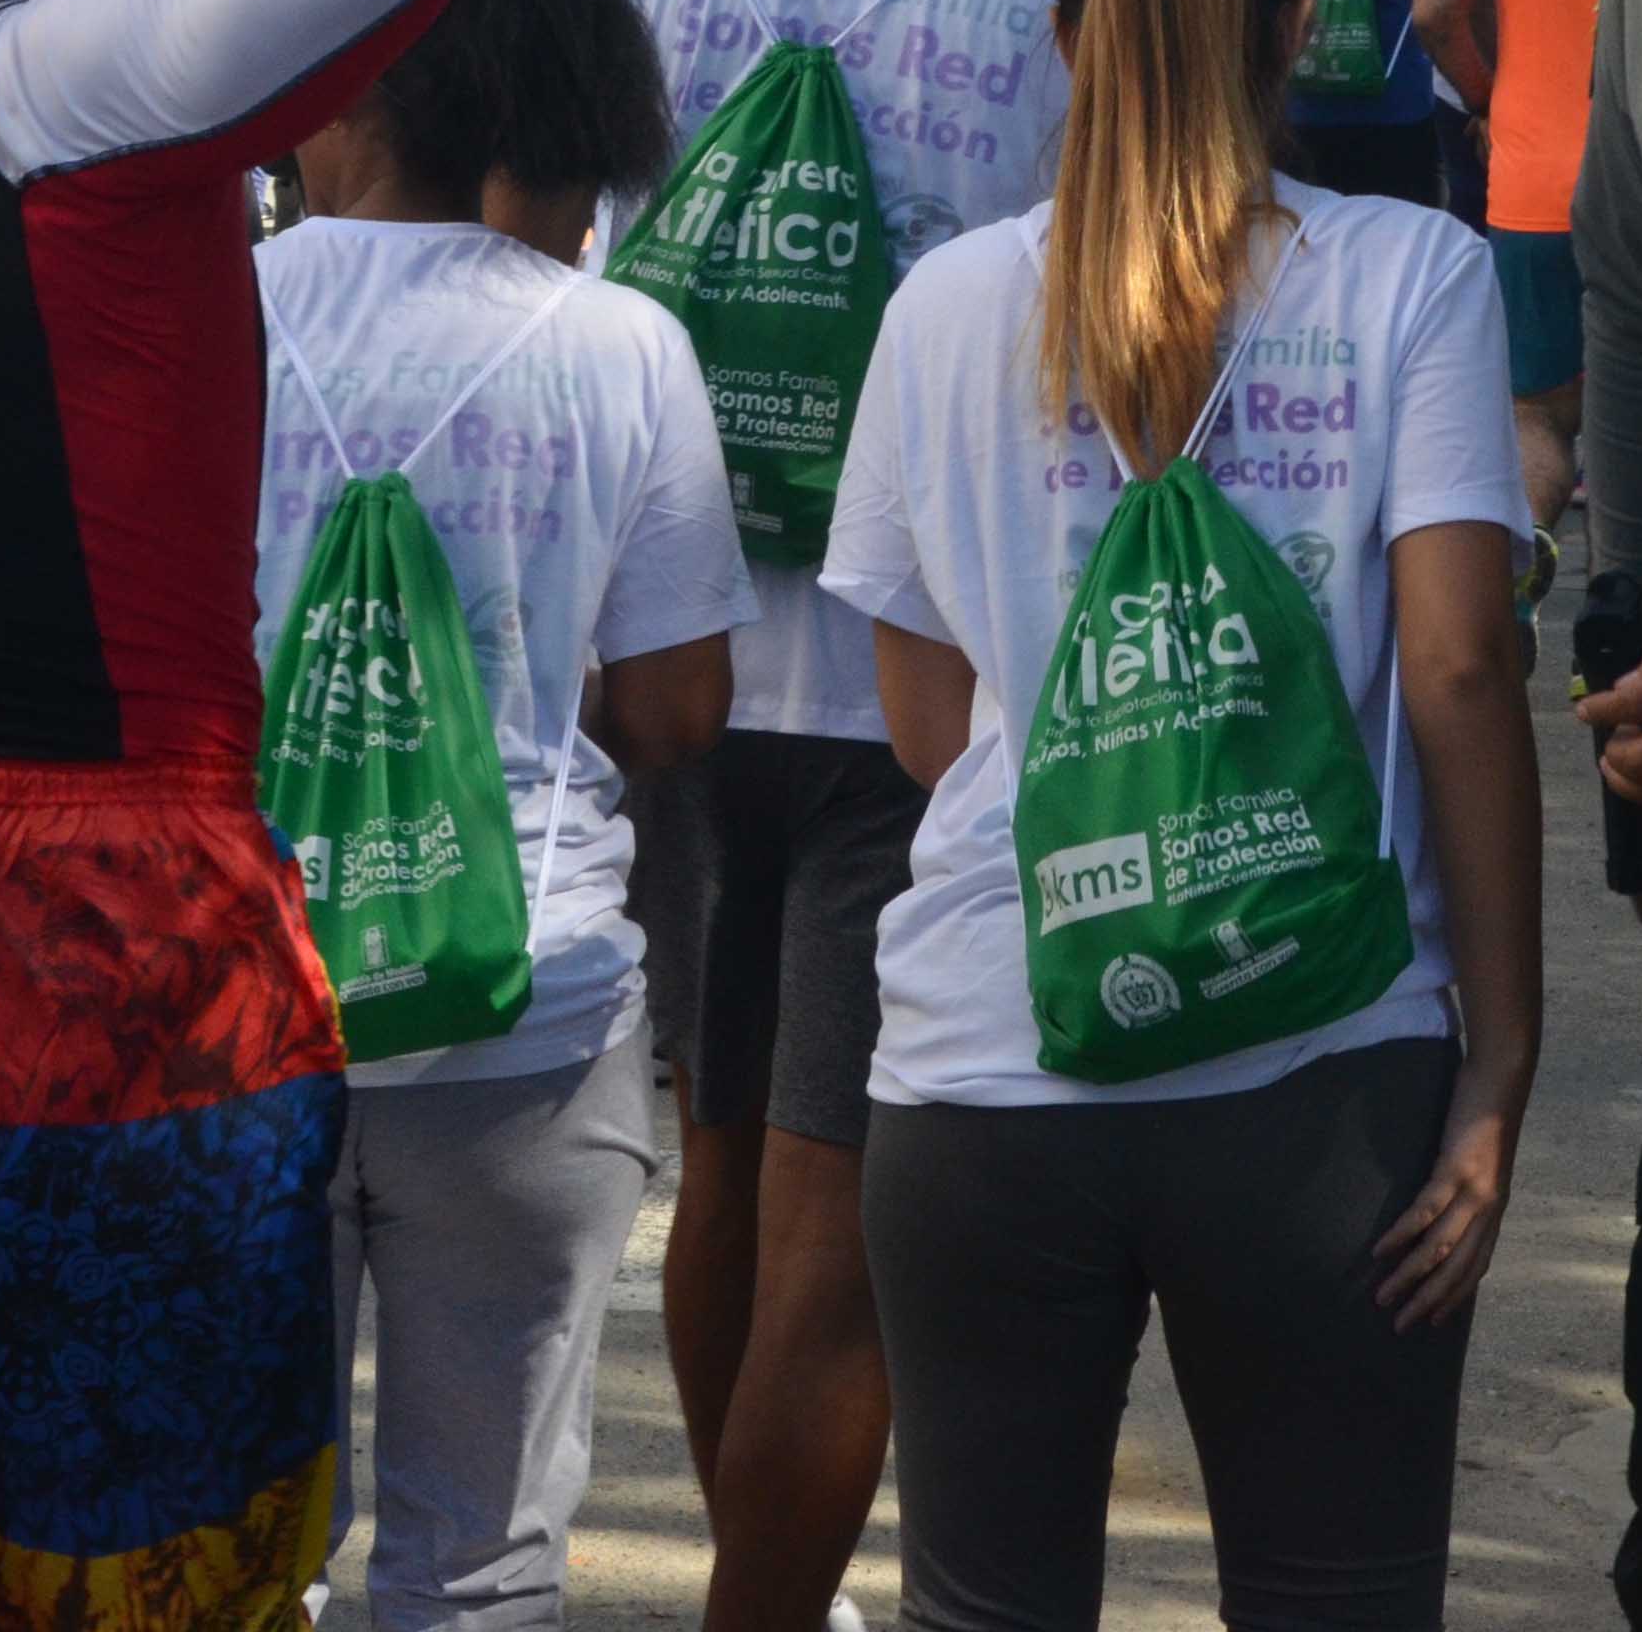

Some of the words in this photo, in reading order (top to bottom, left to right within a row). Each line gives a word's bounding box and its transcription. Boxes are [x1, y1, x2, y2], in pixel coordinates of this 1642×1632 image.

[898, 24, 1027, 108] Red
[1216, 325, 1356, 367] milia
[707, 364, 774, 388] Somos
[707, 384, 793, 415] Somos
[801, 394, 841, 420] Red
[736, 412, 836, 441] Protección
[1246, 379, 1356, 435] Red
[452, 411, 579, 481] Red
[1161, 819, 1249, 866] Somos
[1252, 803, 1312, 836] Red
[1164, 866, 1189, 891] de
[1194, 832, 1322, 880] Protección
